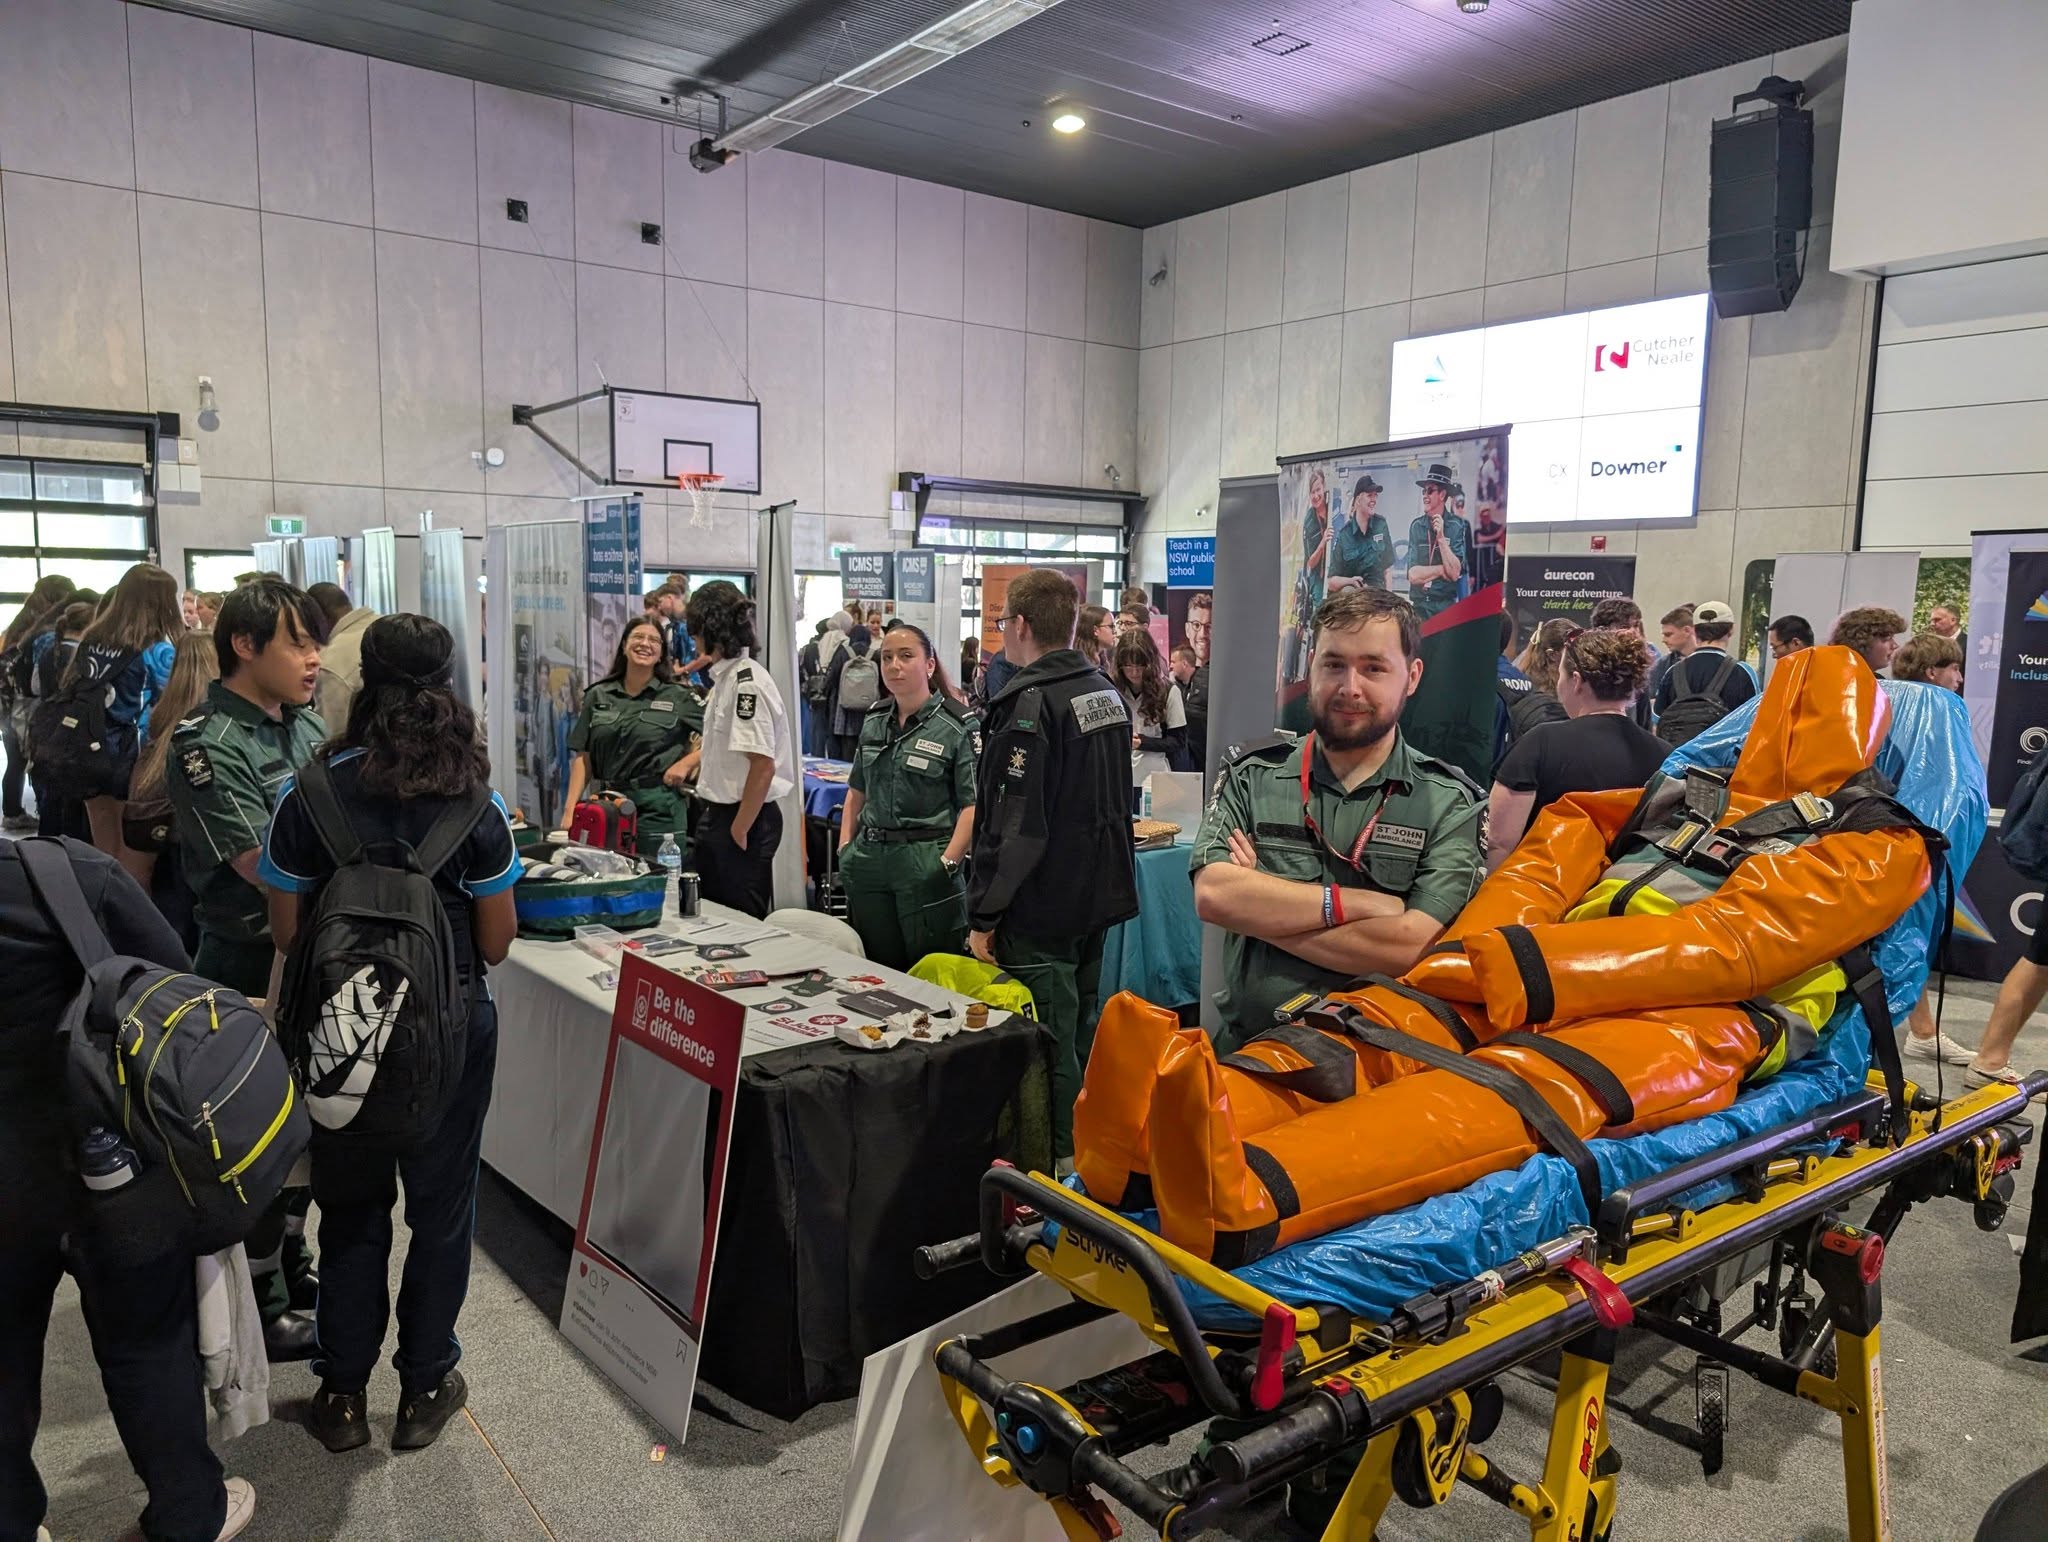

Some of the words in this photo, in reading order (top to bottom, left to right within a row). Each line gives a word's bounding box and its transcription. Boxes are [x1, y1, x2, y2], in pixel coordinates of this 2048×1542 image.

[1633, 336, 1695, 352] Cutcher
[1647, 351, 1694, 366] Neale
[1591, 460, 1667, 477] Downer
[1168, 540, 1193, 550] Teach
[1194, 540, 1202, 550] in
[1203, 541, 1209, 550] a
[848, 556, 873, 572] ICMS
[902, 556, 920, 573] ICMS
[1169, 553, 1189, 563] NSW
[1190, 552, 1216, 564] public
[1169, 565, 1195, 576] school
[1543, 568, 1595, 581] aurecon
[1516, 587, 1538, 598] Your
[1539, 590, 1571, 598] career
[1572, 588, 1623, 599] adventure
[1542, 600, 1570, 610] starts
[1571, 598, 1594, 610] here
[2018, 653, 2048, 666] Your
[1376, 825, 1390, 833] ST
[1392, 829, 1423, 840] JOHN
[1375, 834, 1422, 846] AMBULANCE
[653, 985, 671, 1014] Be
[674, 997, 696, 1026] the
[649, 1015, 715, 1068] difference
